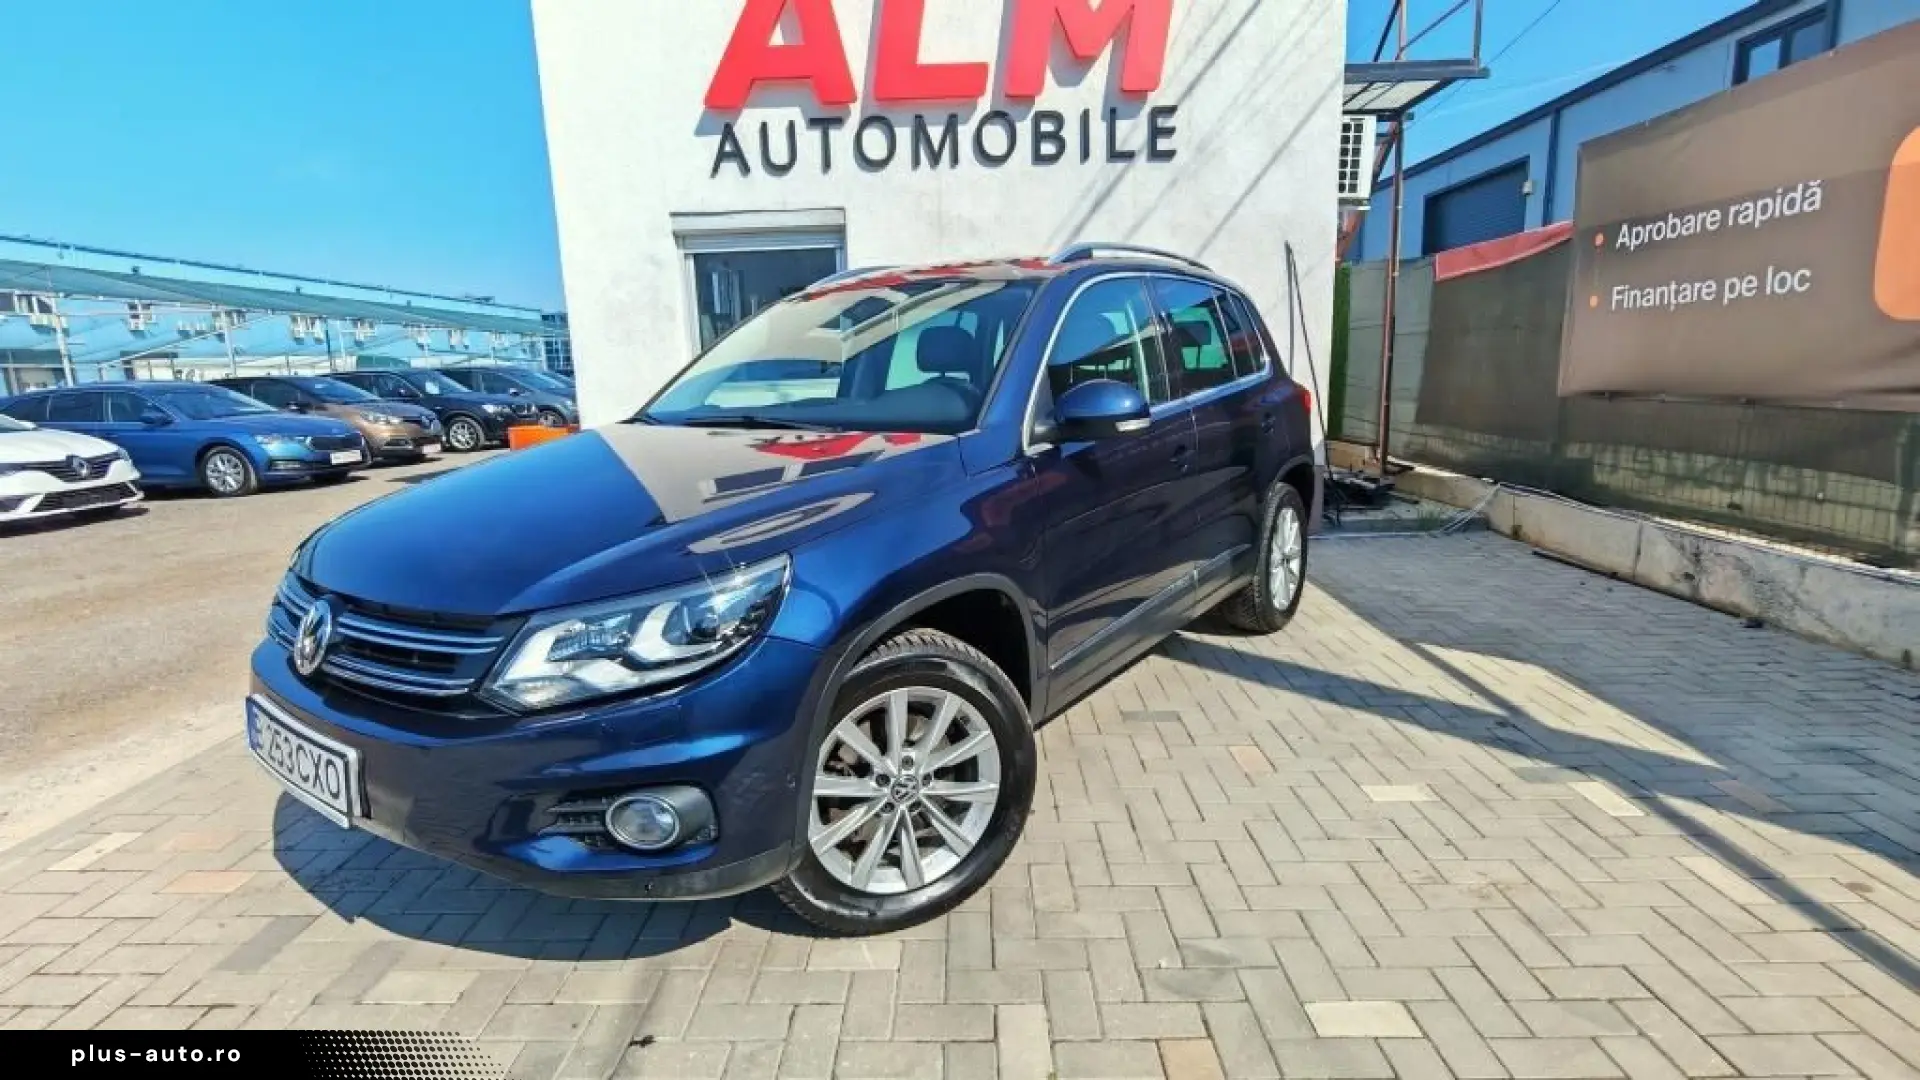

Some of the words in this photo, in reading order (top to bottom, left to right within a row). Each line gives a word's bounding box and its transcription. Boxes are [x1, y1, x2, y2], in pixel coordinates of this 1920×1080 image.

[703, 0, 1174, 108] ALM
[711, 105, 1178, 178] AUTOMOBILE
[1616, 209, 1721, 251] Aprobare
[1728, 179, 1823, 228] rapidă
[1611, 280, 1716, 312] Finanțare
[1723, 274, 1758, 306] pe
[1766, 265, 1812, 296] loc
